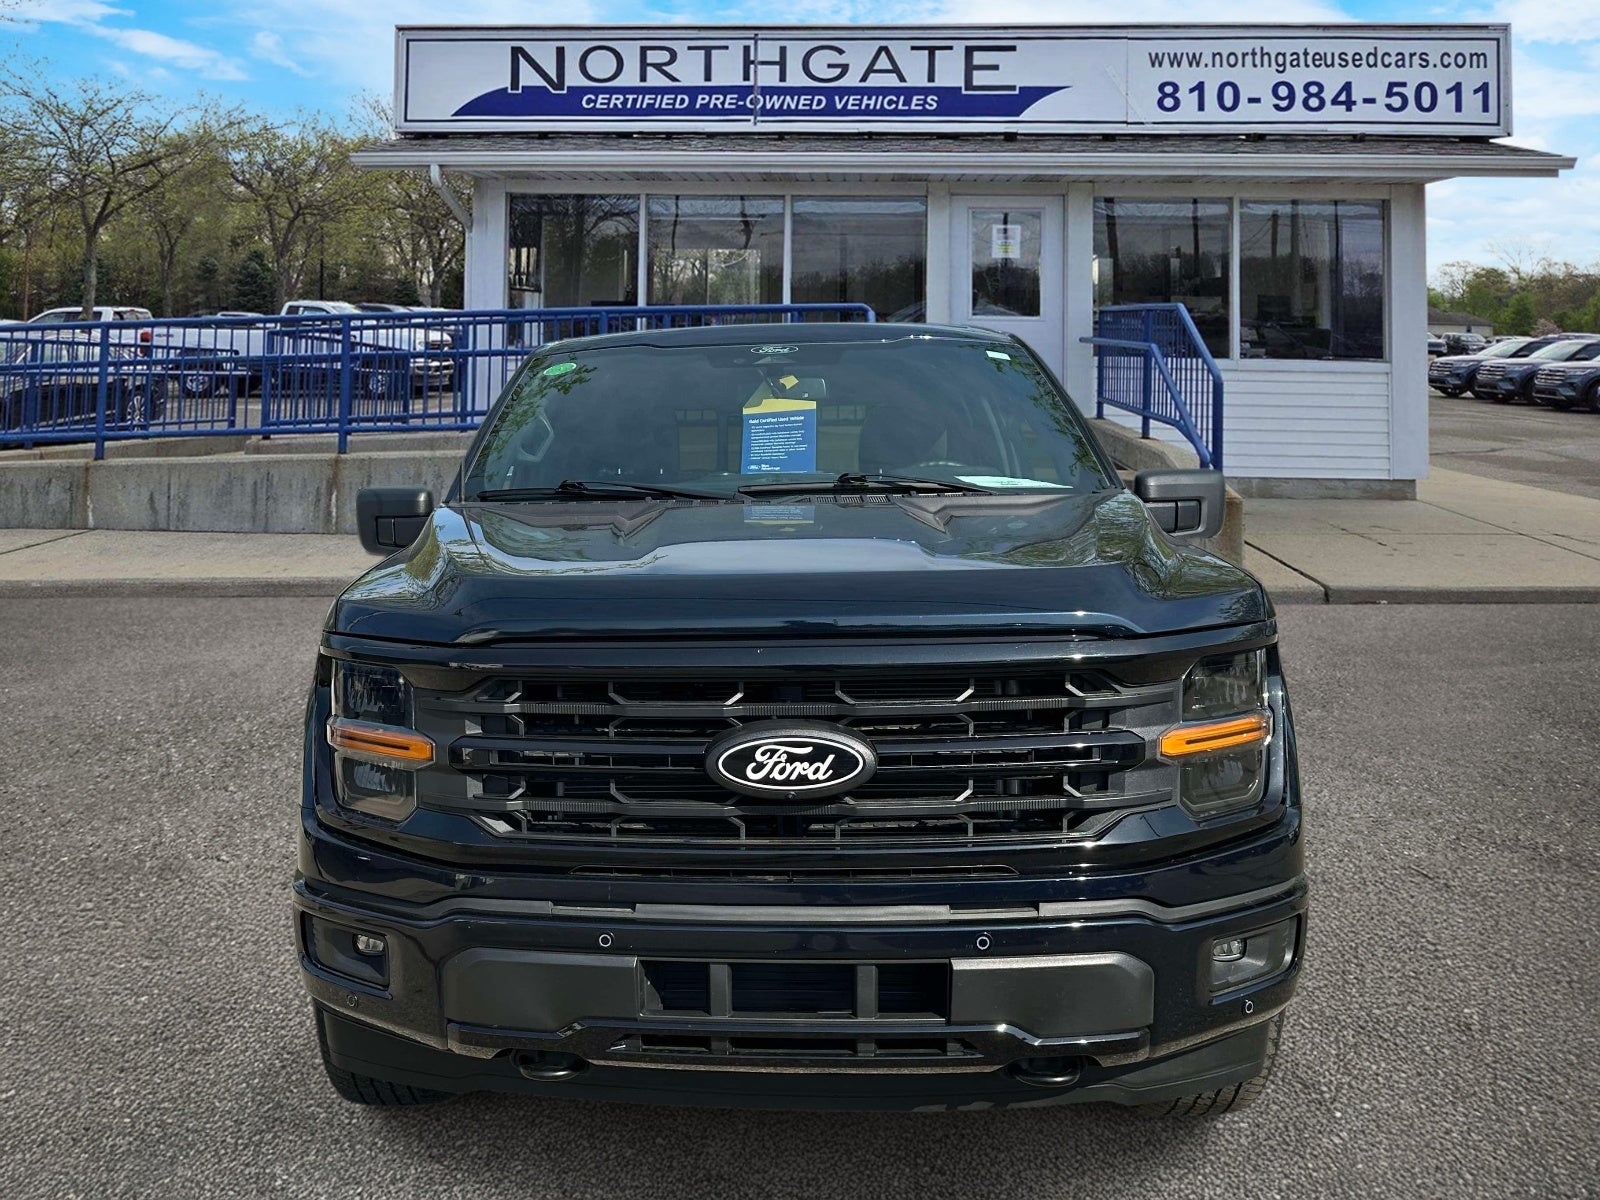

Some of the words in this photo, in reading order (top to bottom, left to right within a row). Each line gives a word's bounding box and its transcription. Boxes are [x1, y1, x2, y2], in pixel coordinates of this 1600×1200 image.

[510, 45, 1017, 91] NORTHGATE
[1148, 46, 1489, 73] www.northgateusedcars.com
[581, 94, 689, 109] CERTIFIED
[695, 94, 827, 109] PRE-OWNED
[834, 95, 939, 110] VEHICLES
[1156, 80, 1491, 114] 810-984-5011
[745, 744, 836, 781] Ford
